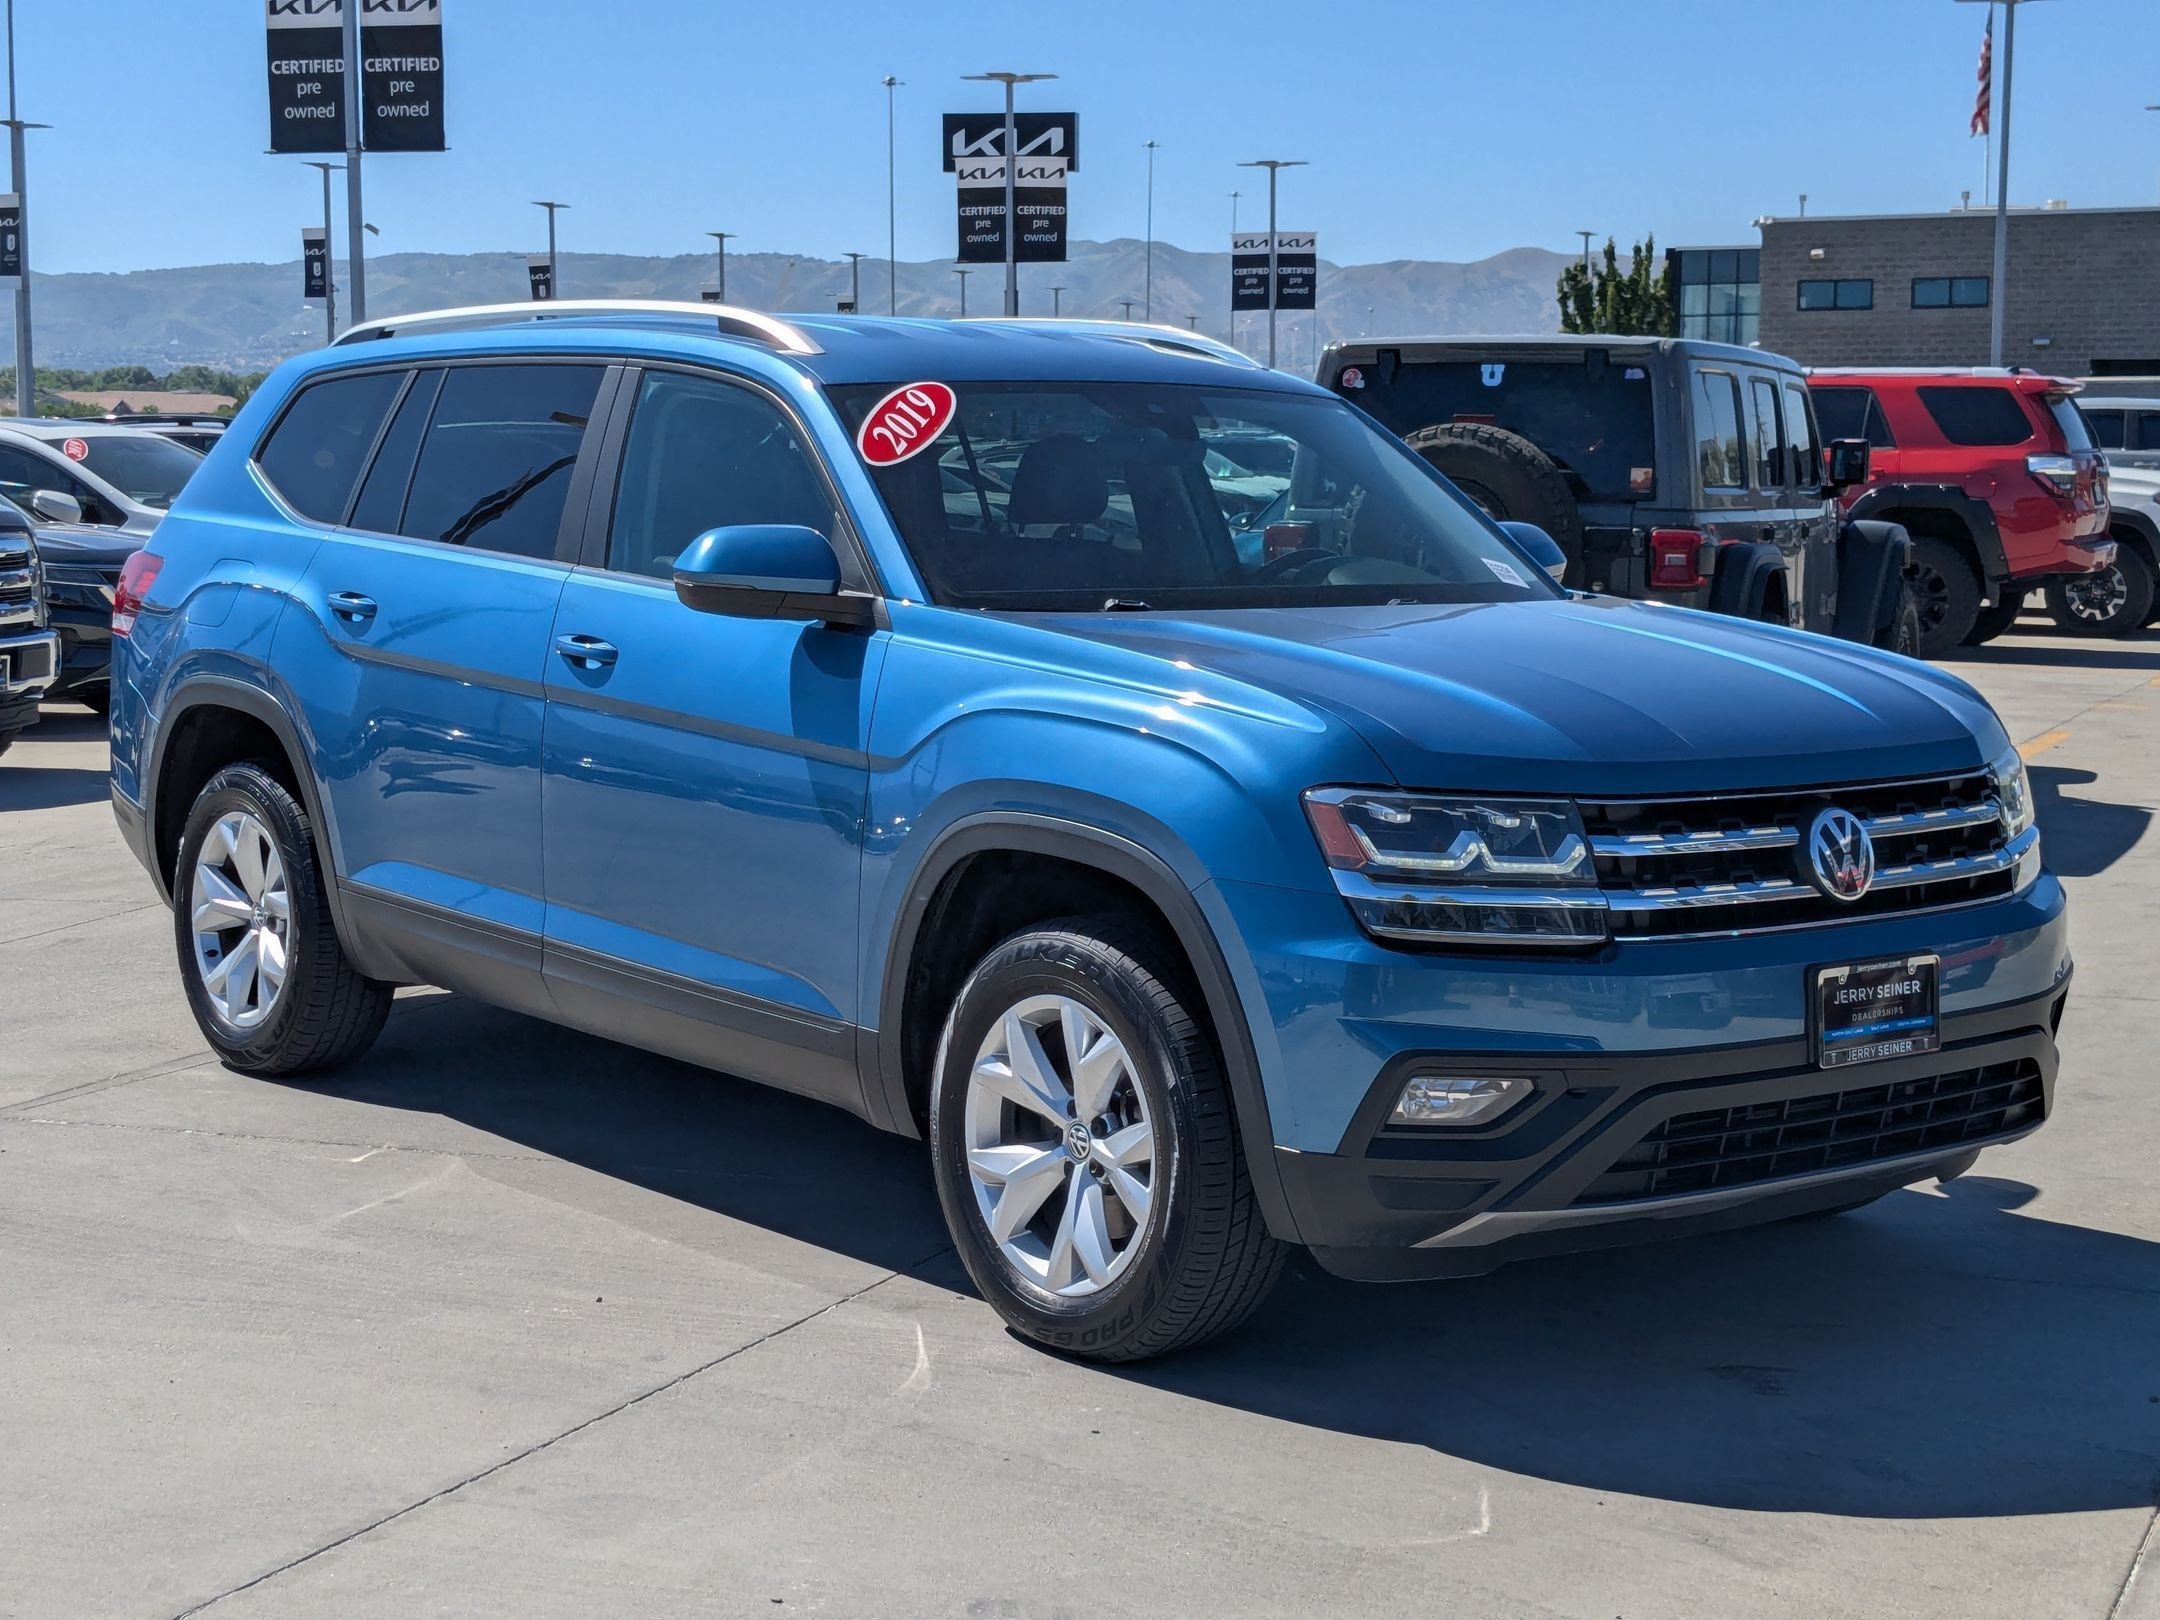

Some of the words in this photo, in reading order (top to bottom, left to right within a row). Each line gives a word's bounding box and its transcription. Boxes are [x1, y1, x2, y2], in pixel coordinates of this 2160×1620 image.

[269, 0, 342, 15] KIA
[363, 0, 437, 12] KIA
[271, 59, 344, 74] CERTIFIED
[365, 58, 440, 72] CERTIFIED
[297, 82, 321, 98] pre
[390, 80, 415, 96] pre
[285, 102, 335, 119] owned
[377, 101, 429, 117] owned
[952, 127, 1064, 156] KIA
[959, 167, 1005, 180] KIA
[1017, 167, 1065, 179] KIA
[960, 206, 1006, 216] CERTIFIED
[1017, 206, 1065, 215] CERTIFIED
[975, 220, 991, 230] pre
[1033, 219, 1049, 229] pre
[967, 232, 999, 242] owned
[1024, 232, 1057, 242] owned
[1234, 239, 1268, 249] KIA
[1278, 239, 1315, 248] KIA
[873, 389, 936, 455] 2019
[1833, 986, 1875, 1005] JERRY
[1876, 980, 1921, 999] SEINER
[1852, 1005, 1904, 1021] DEALERSHIPS
[1846, 1045, 1877, 1061] JERRY
[1877, 1041, 1913, 1056] SEINER
